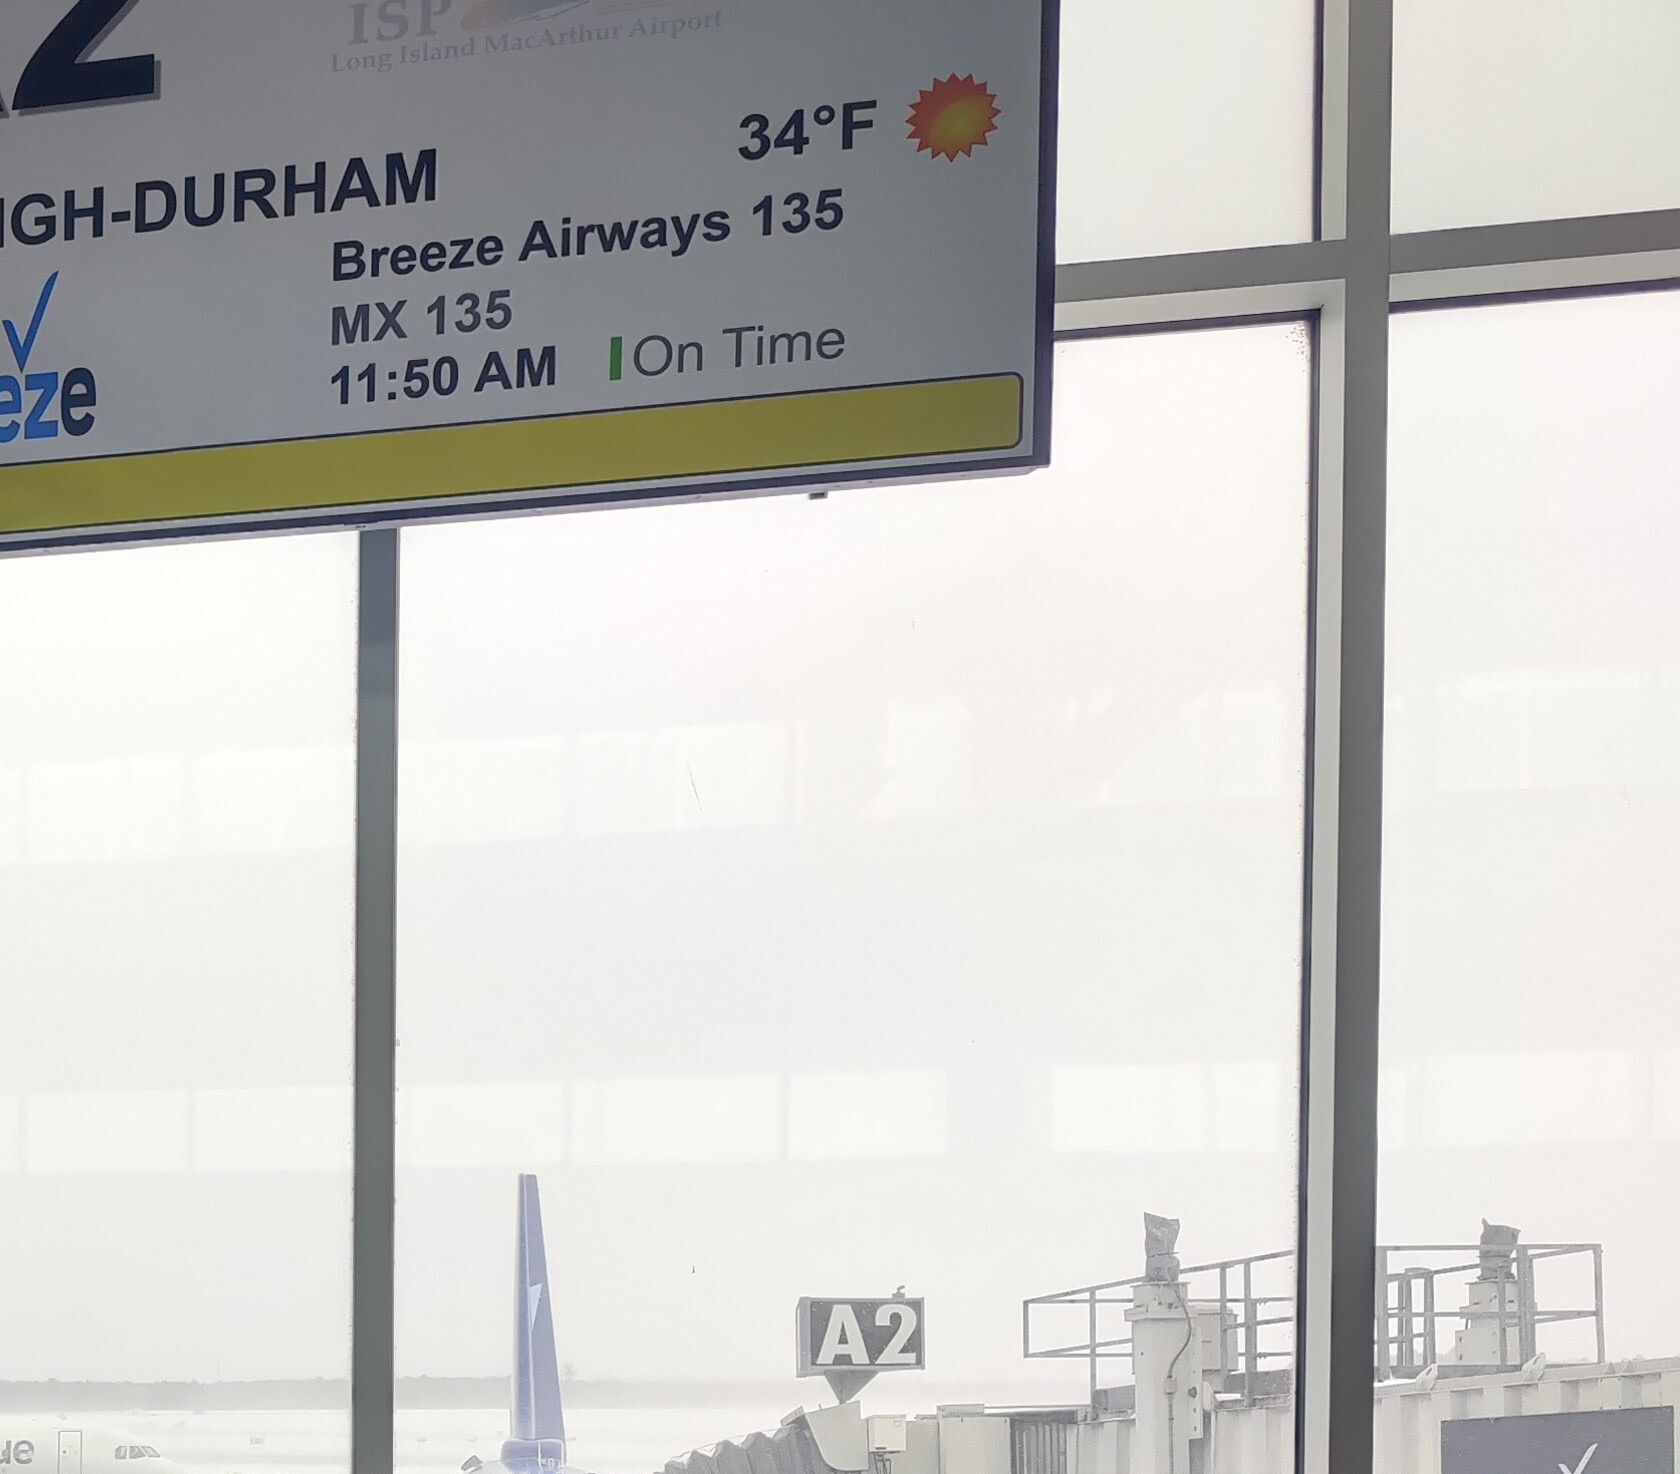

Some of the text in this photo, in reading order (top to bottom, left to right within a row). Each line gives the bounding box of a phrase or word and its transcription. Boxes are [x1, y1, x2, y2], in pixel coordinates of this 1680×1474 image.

[331, 10, 724, 73] Long Island MacArthur Airport
[737, 100, 877, 161] 34°F
[333, 188, 844, 281] Breeze Airways 135
[331, 289, 513, 346] MX 135
[330, 345, 556, 405] 11:50 AM
[633, 324, 845, 377] On Time
[816, 1304, 917, 1365] A2
